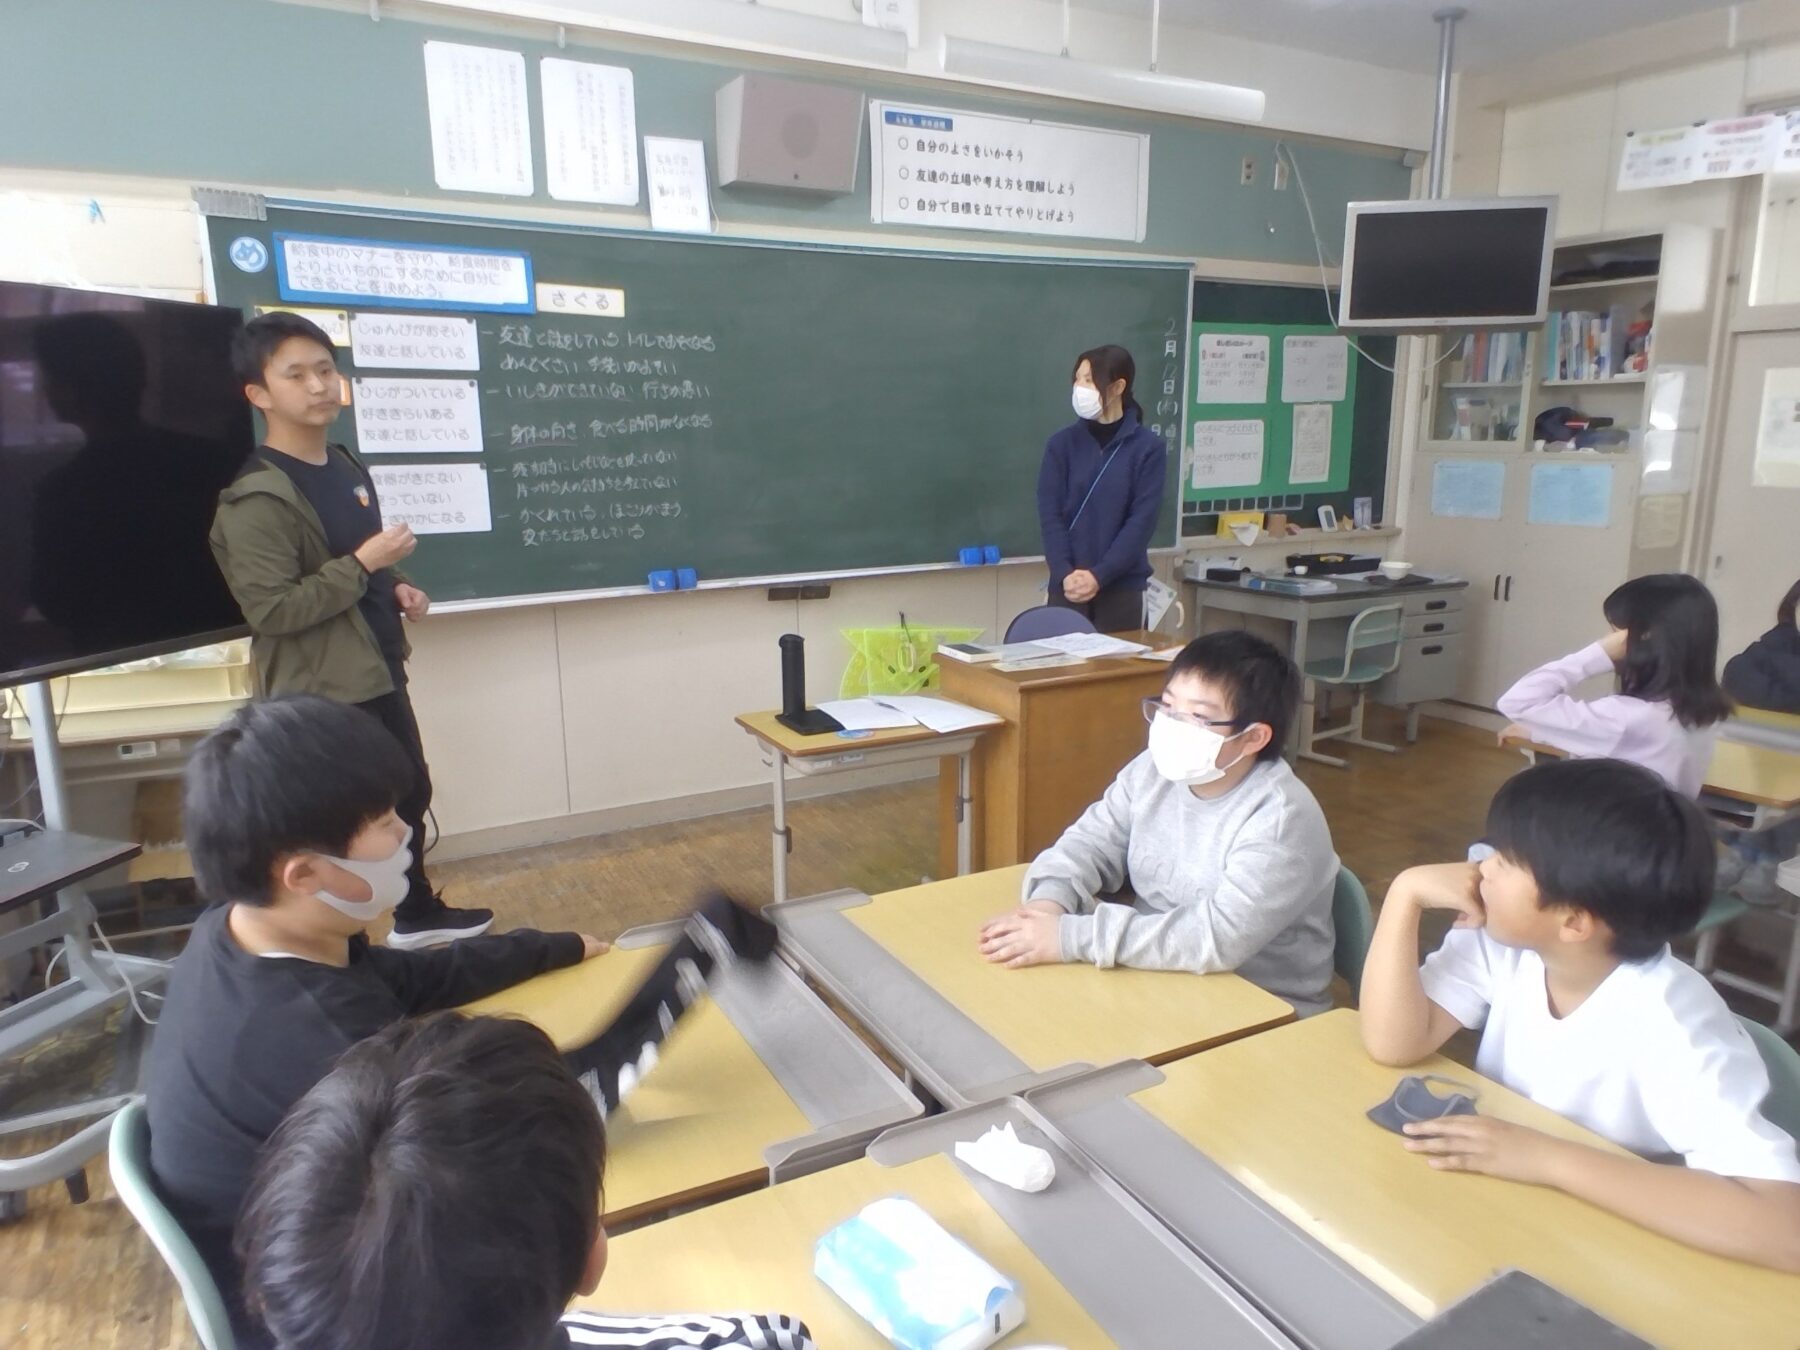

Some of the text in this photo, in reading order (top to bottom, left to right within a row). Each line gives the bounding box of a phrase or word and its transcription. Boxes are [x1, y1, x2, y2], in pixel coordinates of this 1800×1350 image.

[916, 139, 1024, 162] 自分のよさをいかそう
[916, 169, 1076, 196] 友達の立場や考え方を理解しよう
[916, 198, 1076, 223] 自分で目標を立ててやりとげよう
[551, 291, 609, 311] さぐる
[358, 319, 465, 338] じゅんびがおそい
[359, 344, 467, 360] 友達と話している
[359, 385, 467, 400] ひじがついている
[364, 426, 470, 442] 友達と話している
